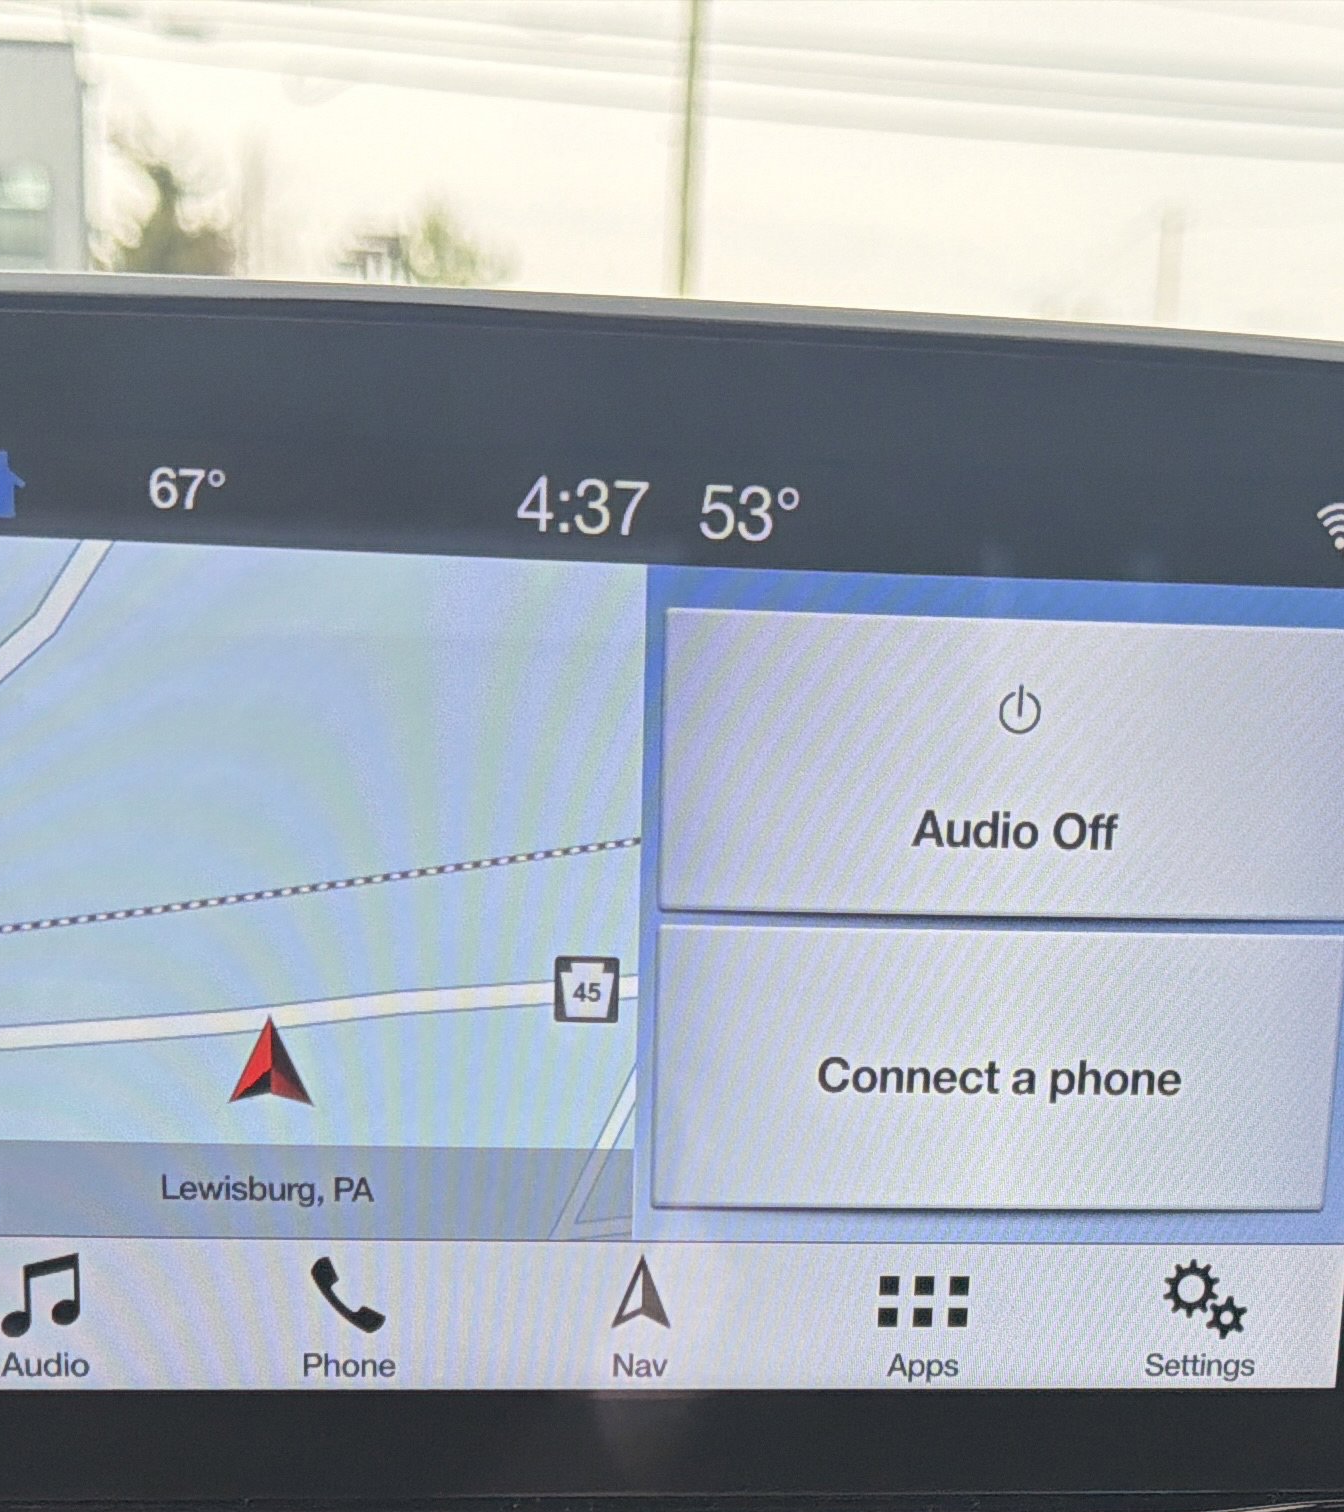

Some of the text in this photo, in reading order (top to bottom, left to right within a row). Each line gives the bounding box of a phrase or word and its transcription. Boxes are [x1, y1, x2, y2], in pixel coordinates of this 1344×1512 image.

[149, 466, 227, 510] 67°
[517, 475, 650, 536] 4:37
[699, 484, 800, 542] 53°
[911, 809, 1120, 852] Audio Off
[572, 980, 602, 1004] 45
[817, 1056, 1183, 1104] Connect a phone
[160, 1173, 376, 1209] Lewisburg, PA
[0, 1350, 91, 1379] Audio
[302, 1352, 397, 1379] Phone
[612, 1353, 668, 1379] Nav
[886, 1353, 960, 1384] Apps
[1144, 1352, 1256, 1382] Settings
